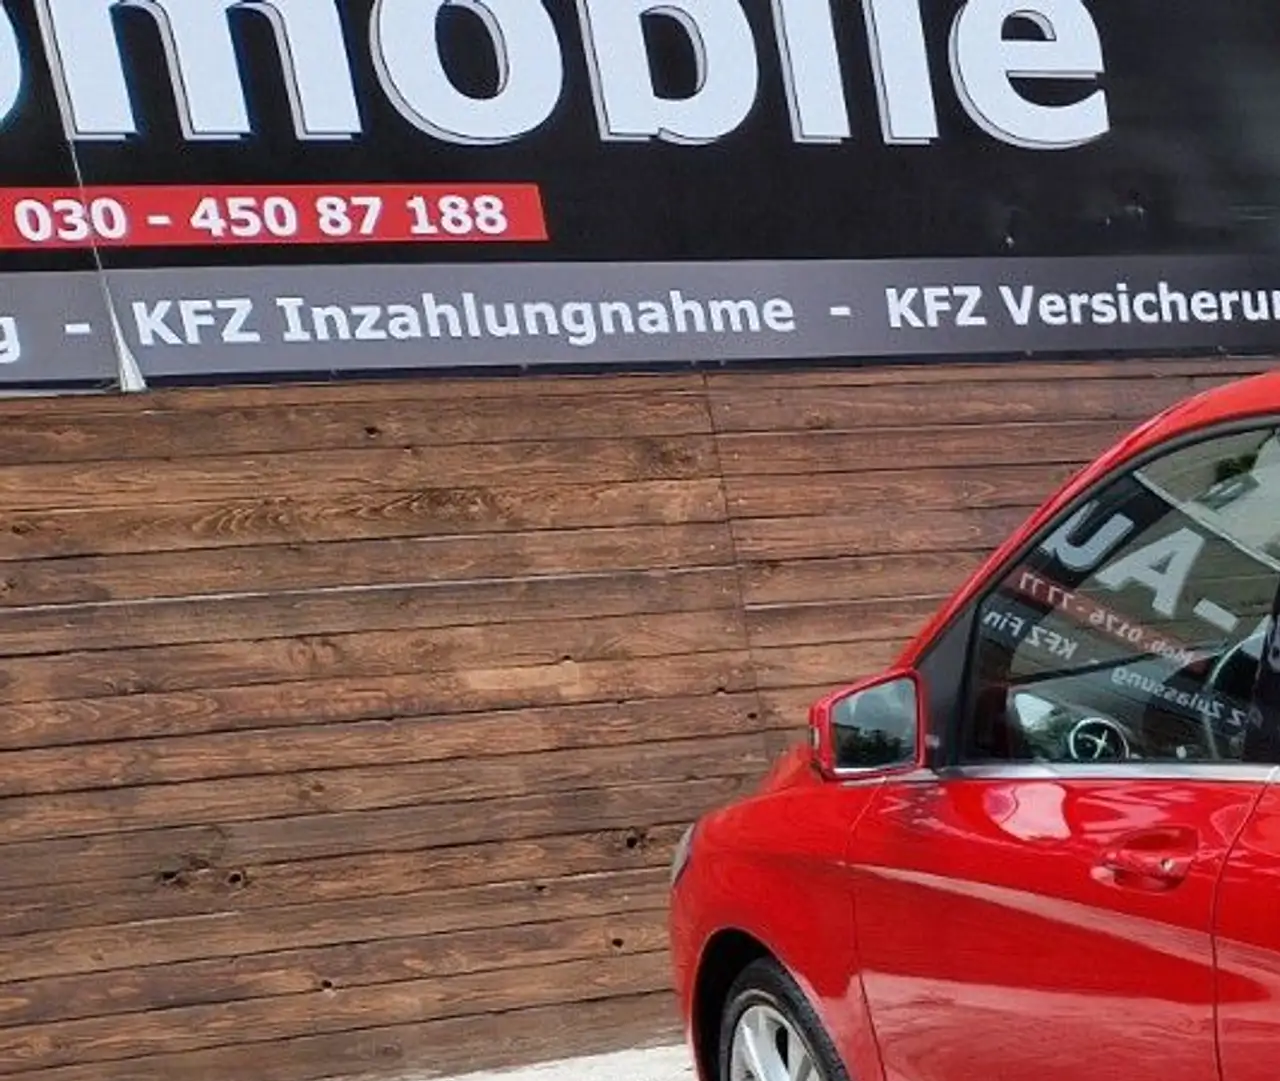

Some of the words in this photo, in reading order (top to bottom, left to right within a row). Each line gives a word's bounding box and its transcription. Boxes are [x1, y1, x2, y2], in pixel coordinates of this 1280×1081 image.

[0, 0, 1110, 150] mobile
[14, 197, 128, 242] 030
[147, 214, 170, 227] -
[190, 196, 298, 238] 450
[317, 195, 382, 236] 87
[406, 195, 507, 235] 188
[65, 325, 91, 335] -
[131, 297, 261, 347] KFZ
[276, 289, 797, 346] Inzahlungnahme
[829, 305, 851, 316] -
[885, 285, 987, 328] KFZ
